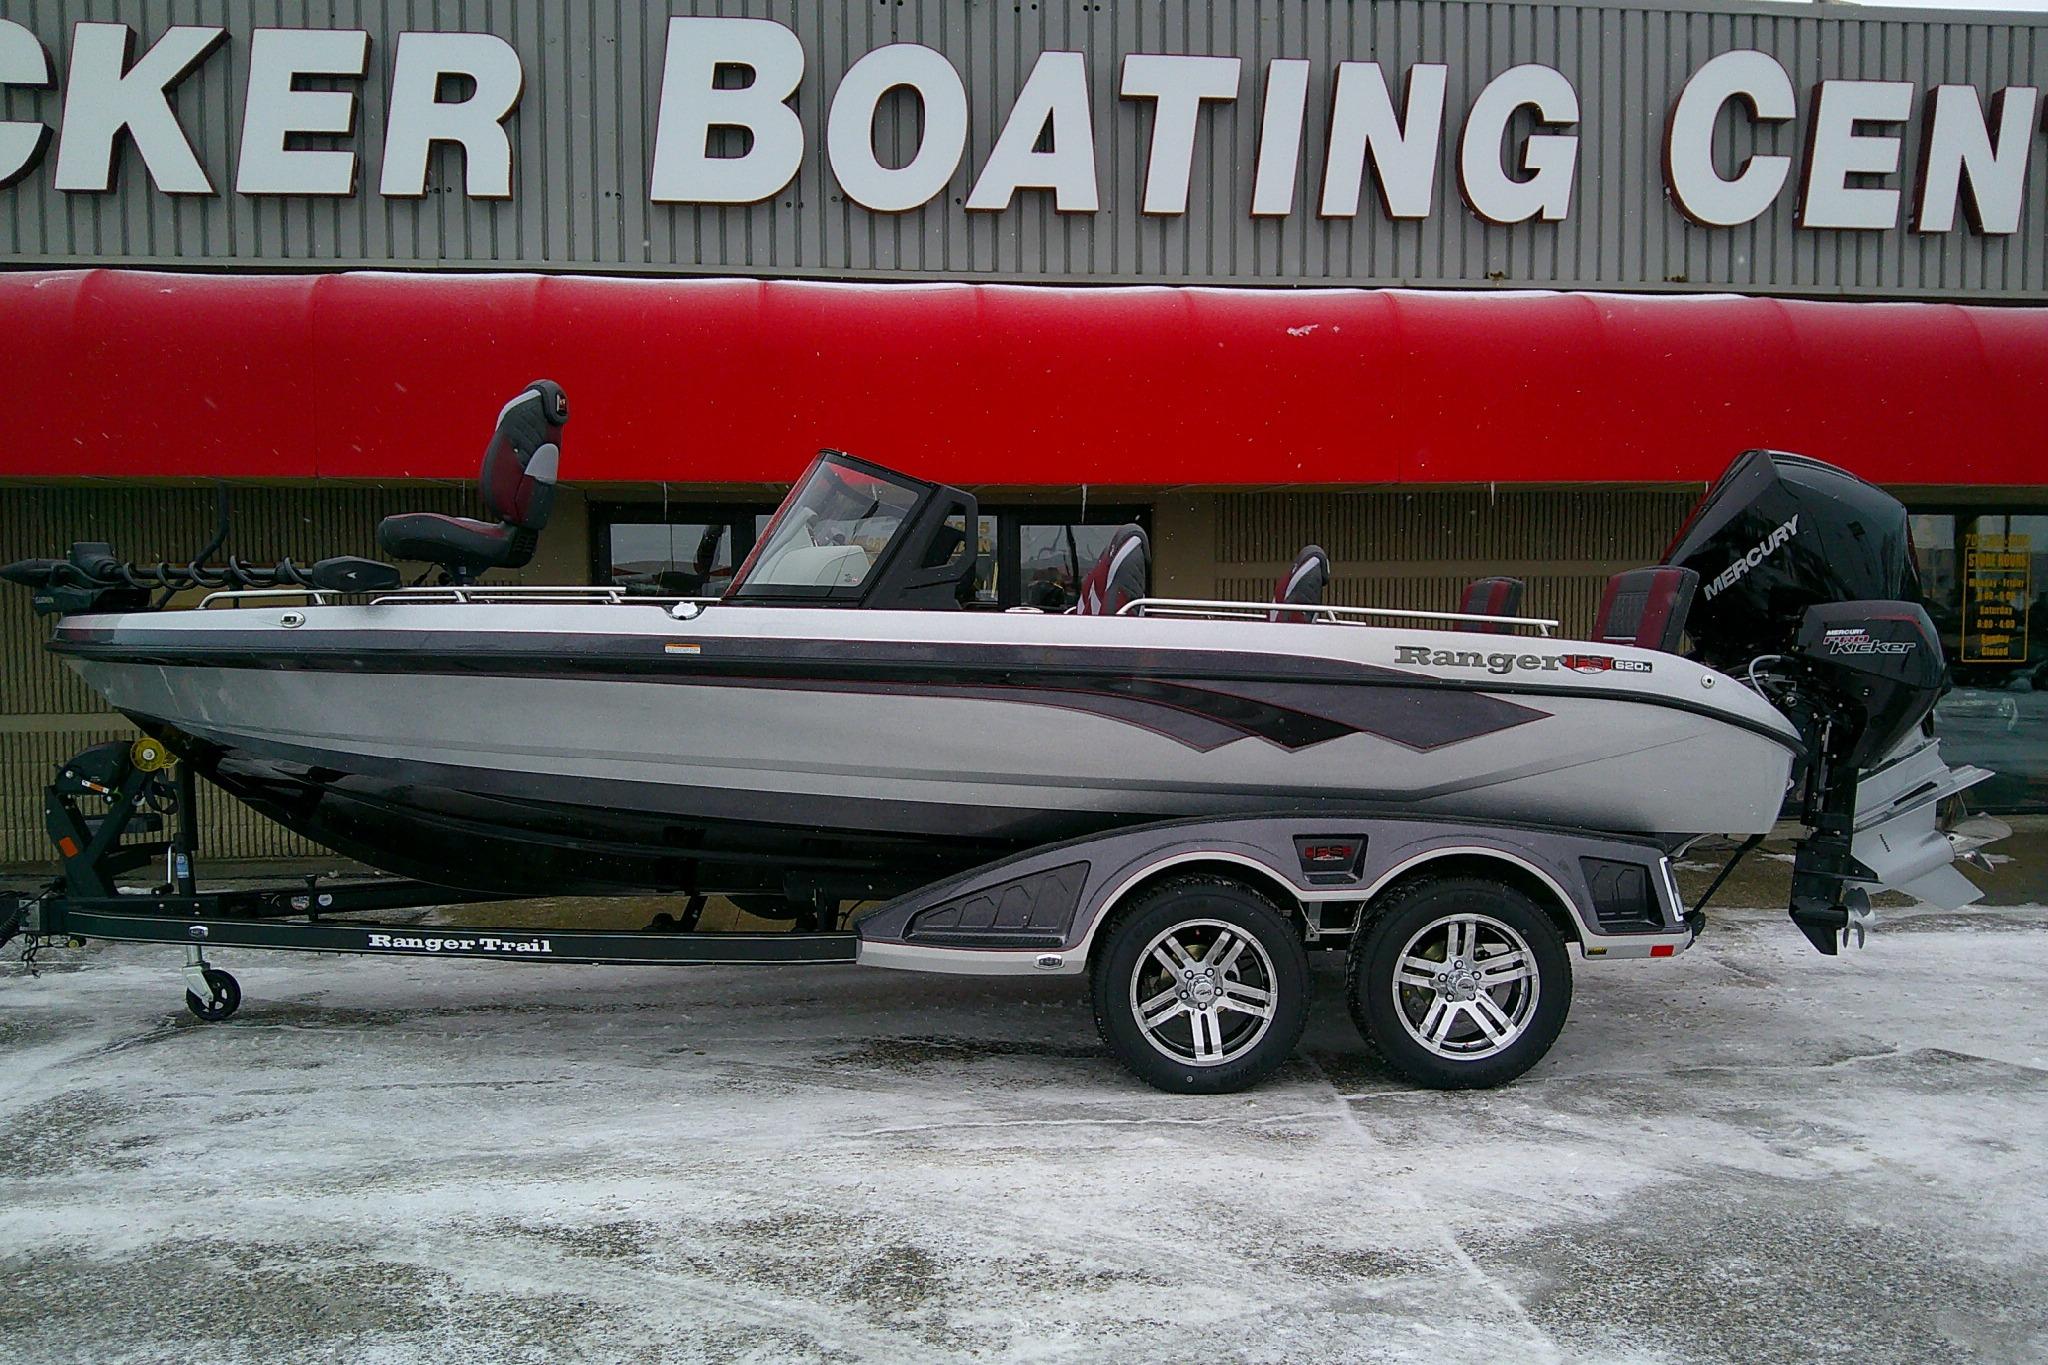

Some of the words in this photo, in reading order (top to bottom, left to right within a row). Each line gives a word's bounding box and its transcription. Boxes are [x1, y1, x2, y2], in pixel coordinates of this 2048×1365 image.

[650, 16, 1580, 224] BOATING
[1666, 49, 2048, 235] CEN
[1703, 514, 1799, 601] MERCURY
[1980, 605, 2013, 615] Saturday
[1825, 628, 1866, 636] MERCURY
[1829, 640, 1917, 655] Kicker
[1981, 646, 2009, 656] Closed
[1394, 645, 1564, 674] Ranger
[368, 934, 475, 951] Ranger
[478, 937, 552, 952] Trail
